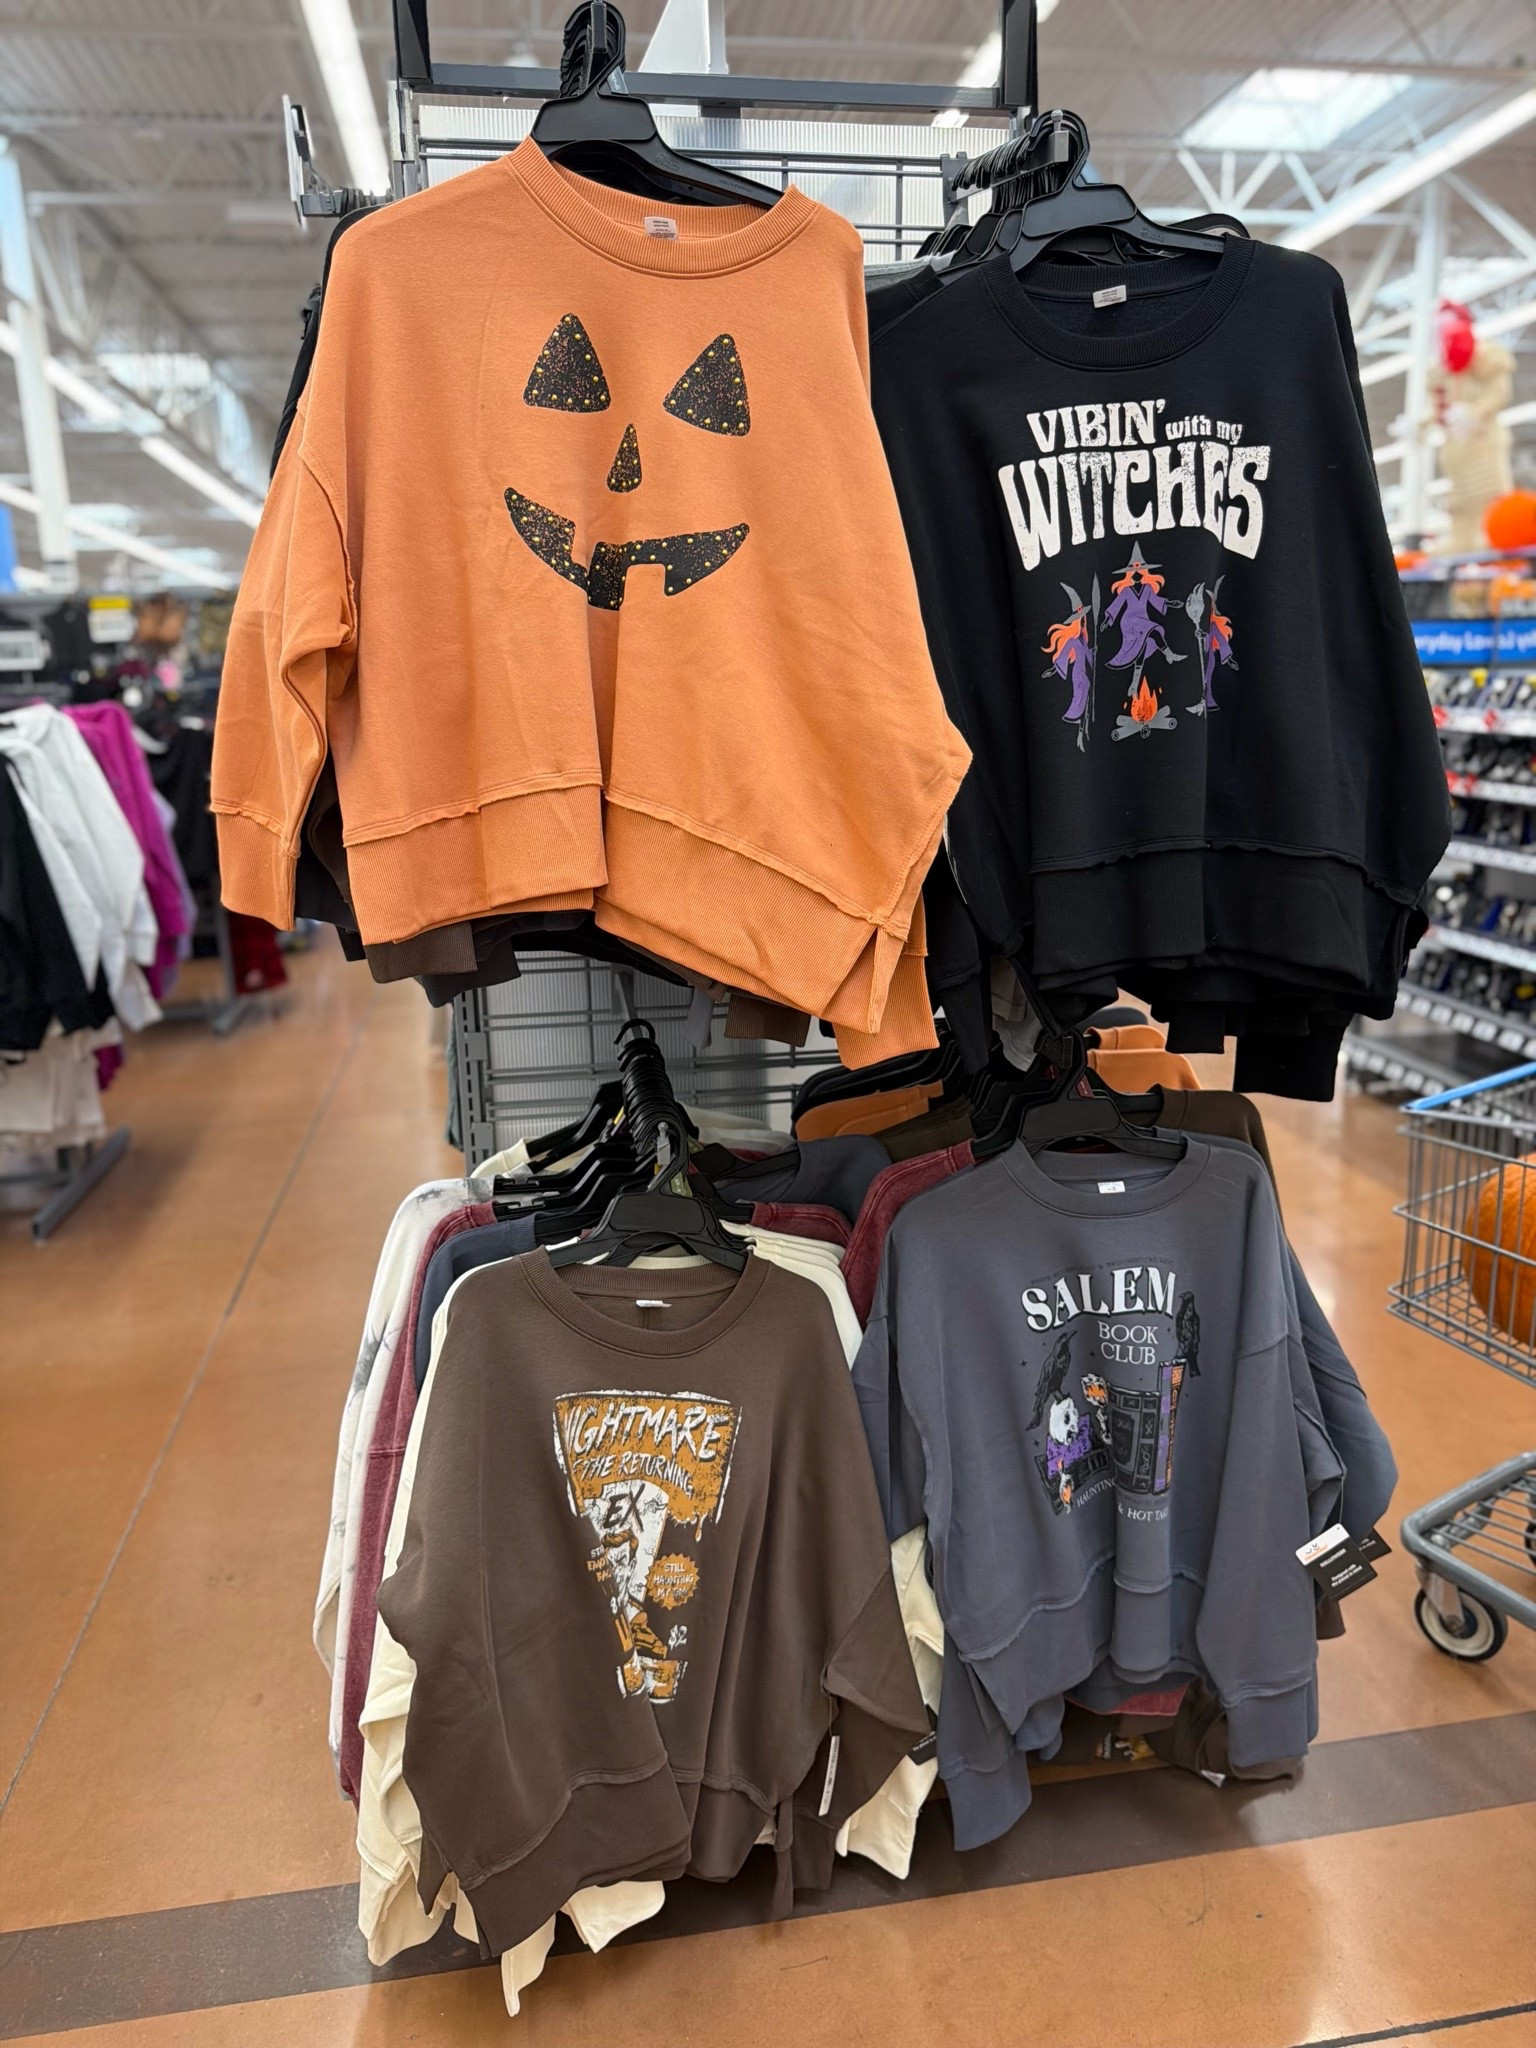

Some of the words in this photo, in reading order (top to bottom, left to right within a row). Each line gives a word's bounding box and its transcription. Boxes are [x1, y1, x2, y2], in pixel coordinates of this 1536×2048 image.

[1026, 399, 1165, 452] VIBIN'
[1165, 414, 1211, 441] with
[1216, 421, 1243, 445] my
[998, 441, 1271, 571] WITCHES
[1021, 1266, 1177, 1331] SALEM
[1098, 1321, 1159, 1345] BOOK
[1101, 1341, 1156, 1365] CLUB
[581, 1454, 615, 1481] THE
[618, 1451, 694, 1499] RETURNING
[603, 1484, 644, 1532] EX
[1127, 1507, 1154, 1522] HOT
[653, 1573, 694, 1585] HAUNTING
[664, 1563, 685, 1573] STILL
